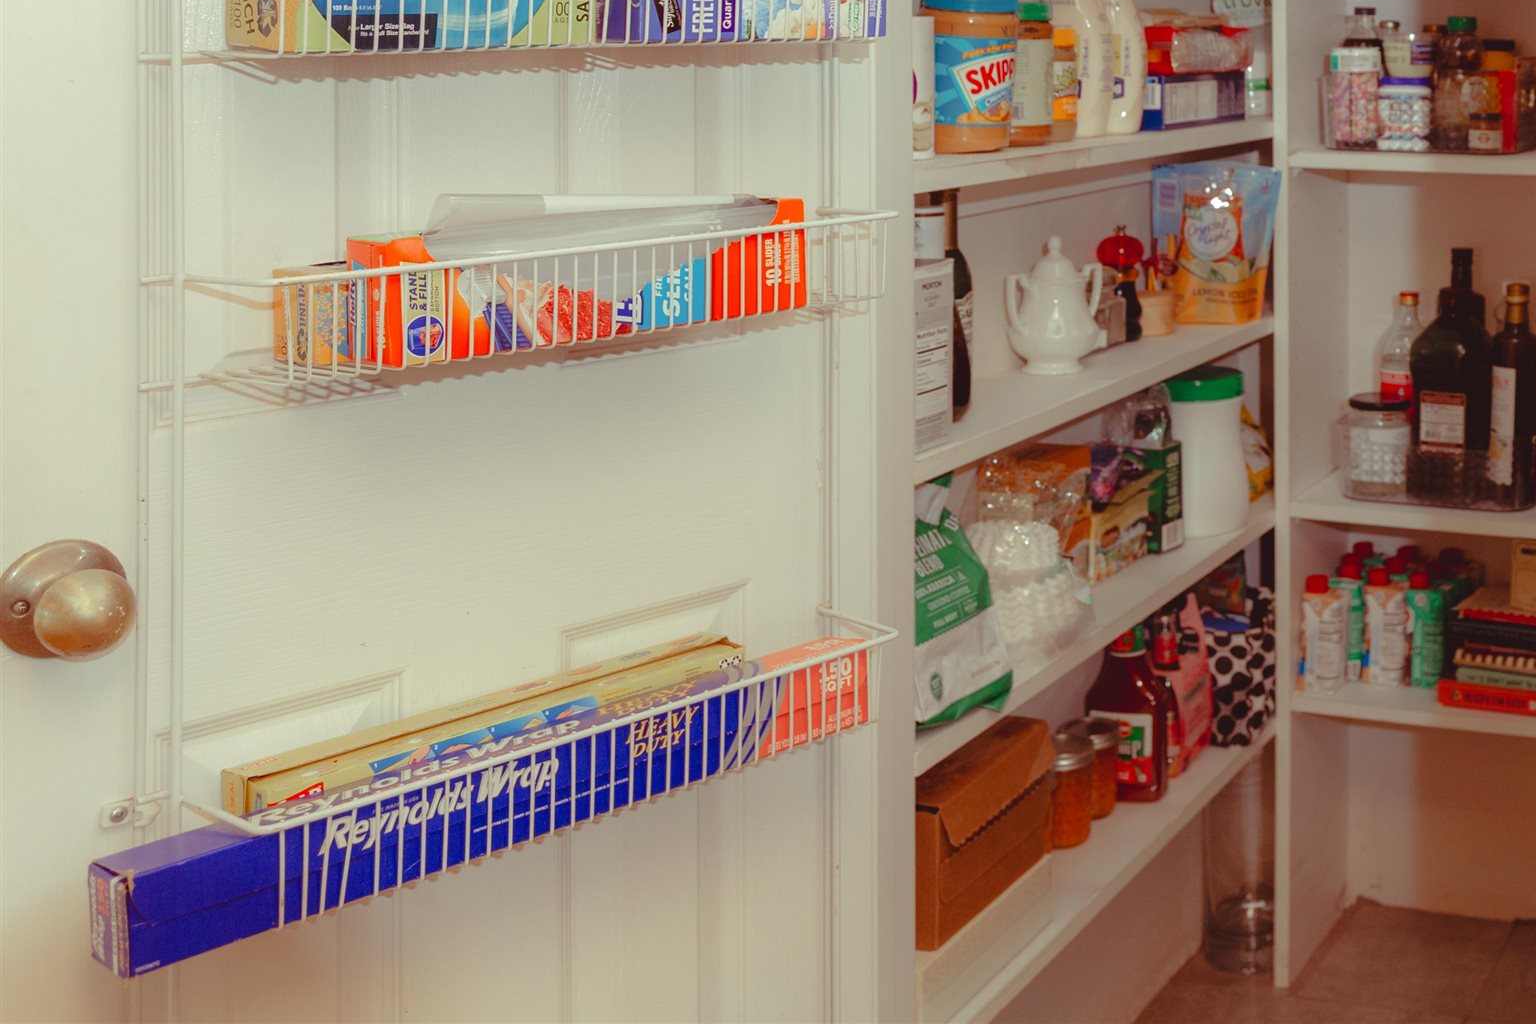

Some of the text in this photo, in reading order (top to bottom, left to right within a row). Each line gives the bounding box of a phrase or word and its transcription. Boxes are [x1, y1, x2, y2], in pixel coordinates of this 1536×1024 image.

[360, 22, 383, 31] Largr
[385, 22, 399, 30] Size
[965, 57, 1016, 95] SKIPP
[765, 238, 782, 287] 10 SLIDER
[350, 278, 358, 325] Hefty
[408, 271, 418, 311] STAND
[418, 301, 427, 312] &
[465, 718, 581, 759] Wrap
[625, 705, 700, 745] HEAVY
[634, 728, 686, 758] DUTY
[249, 754, 460, 827] Reynolds
[318, 779, 474, 857] Reynolds
[476, 756, 560, 804] Wrap
